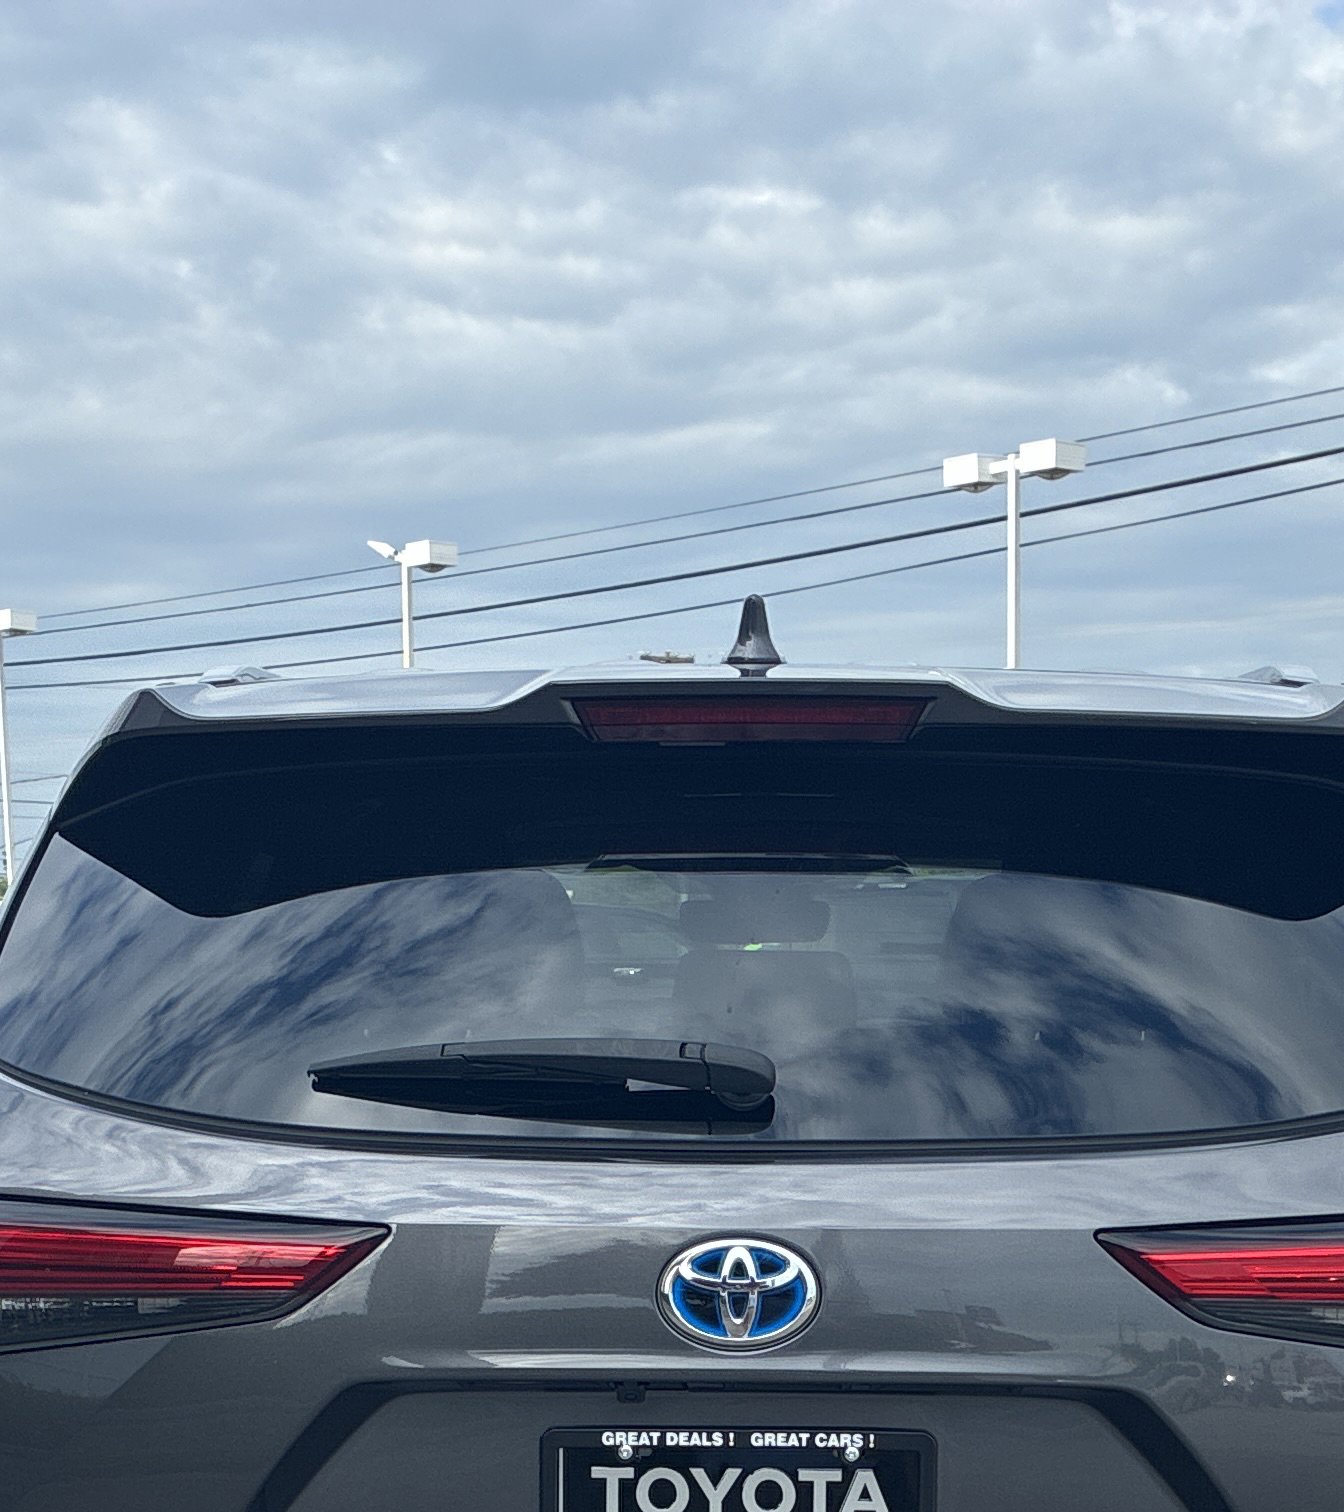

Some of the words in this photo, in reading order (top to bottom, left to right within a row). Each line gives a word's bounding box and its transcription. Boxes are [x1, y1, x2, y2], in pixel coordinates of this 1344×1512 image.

[601, 1431, 661, 1447] GREAT
[665, 1432, 724, 1447] DEALS
[750, 1433, 810, 1447] GREAT
[815, 1433, 864, 1448] CARS
